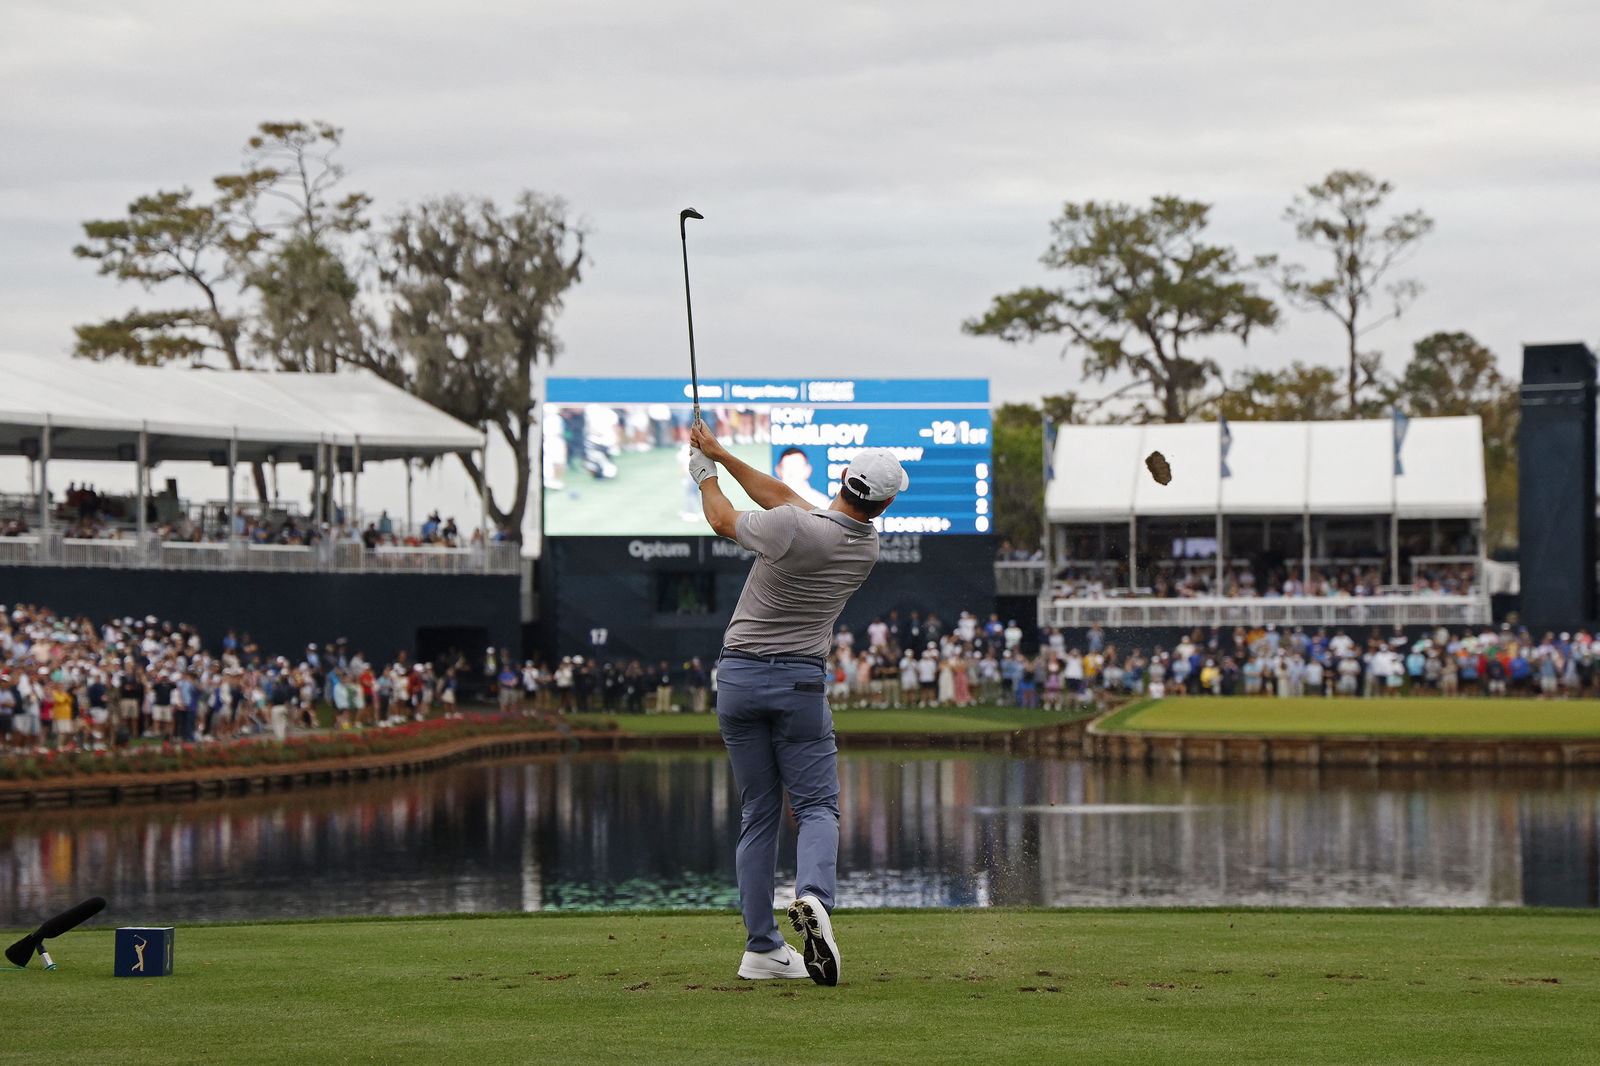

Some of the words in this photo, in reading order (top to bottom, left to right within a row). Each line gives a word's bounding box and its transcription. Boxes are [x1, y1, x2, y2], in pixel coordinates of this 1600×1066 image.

[628, 540, 691, 561] Optum
[712, 541, 757, 561] Morg
[590, 628, 608, 645] 17
